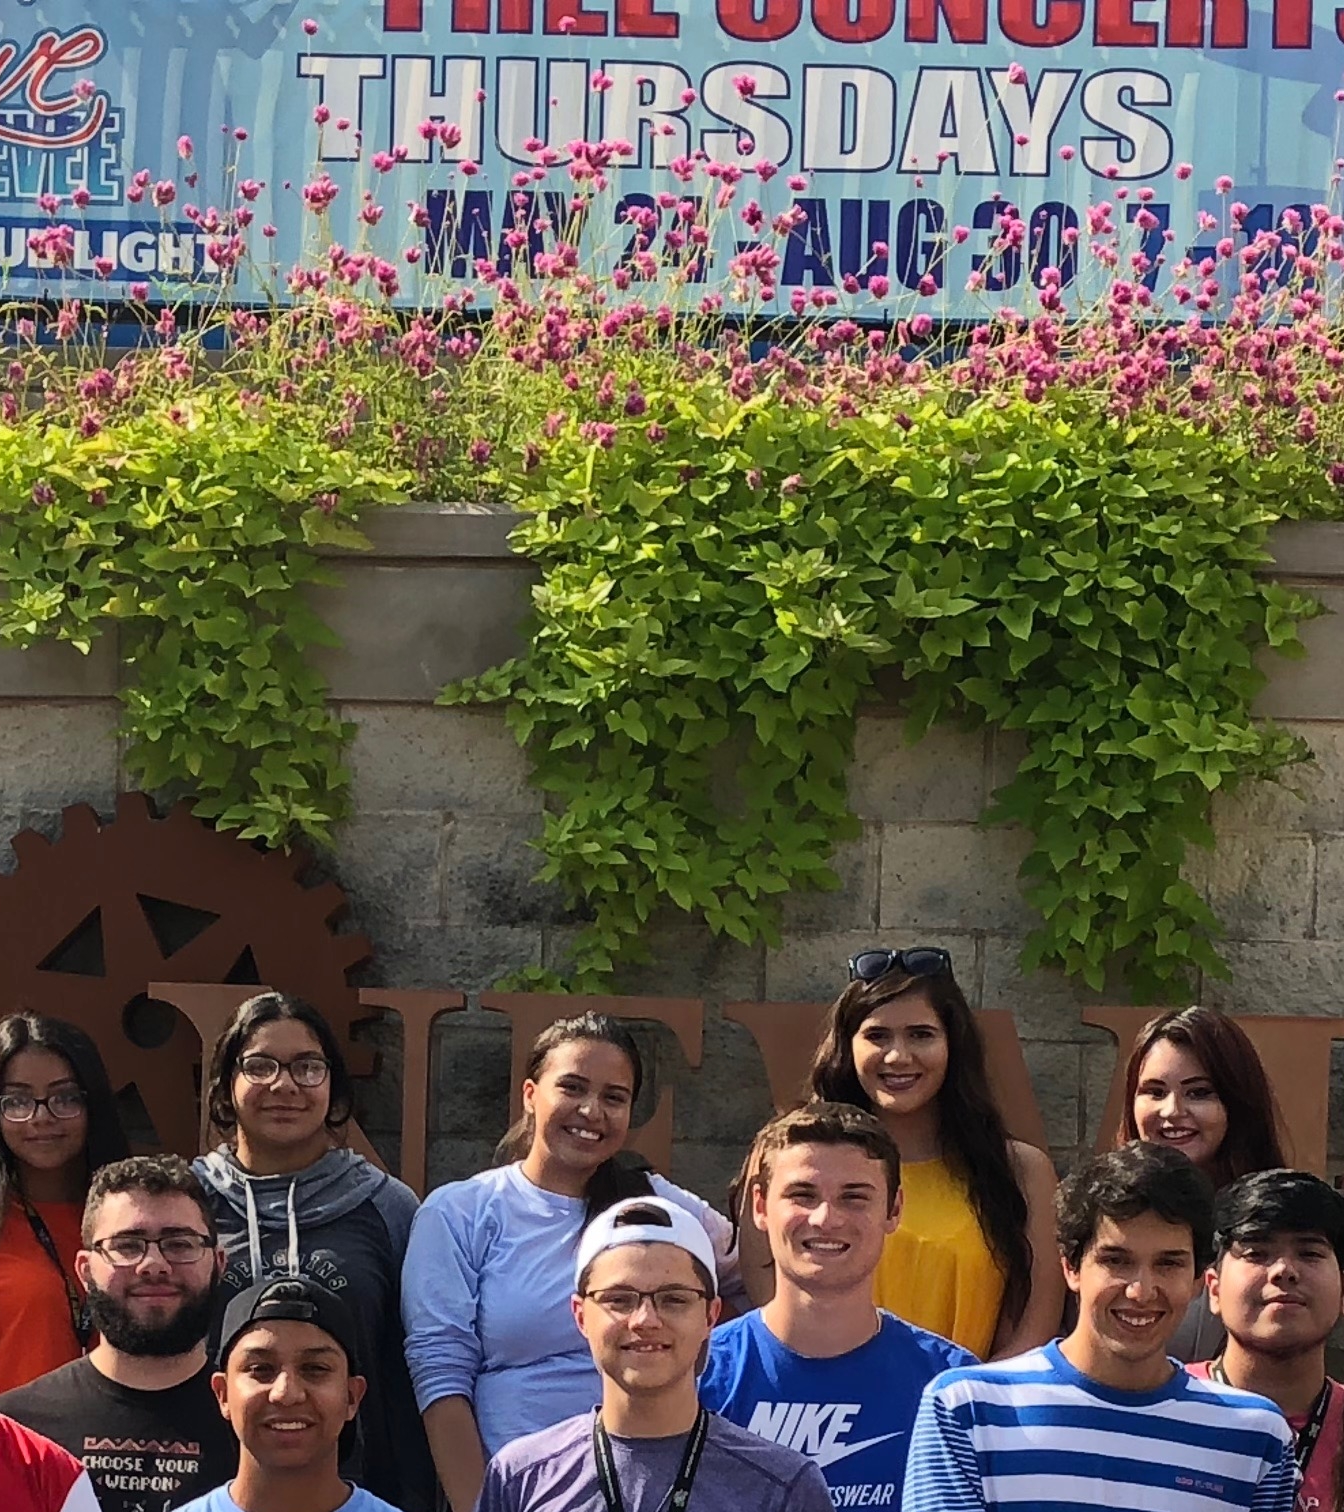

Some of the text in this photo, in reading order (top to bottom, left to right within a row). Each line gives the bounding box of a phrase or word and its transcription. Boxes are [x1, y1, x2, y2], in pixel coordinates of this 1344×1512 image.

[297, 53, 1173, 181] THURSDAYS
[780, 198, 945, 291] AUG
[971, 200, 1080, 293] 30
[223, 1248, 349, 1290] PEGINS
[747, 1401, 862, 1456] NIKE
[81, 1455, 199, 1474] CHOOSE YOUR
[105, 1474, 174, 1492] WEAPON
